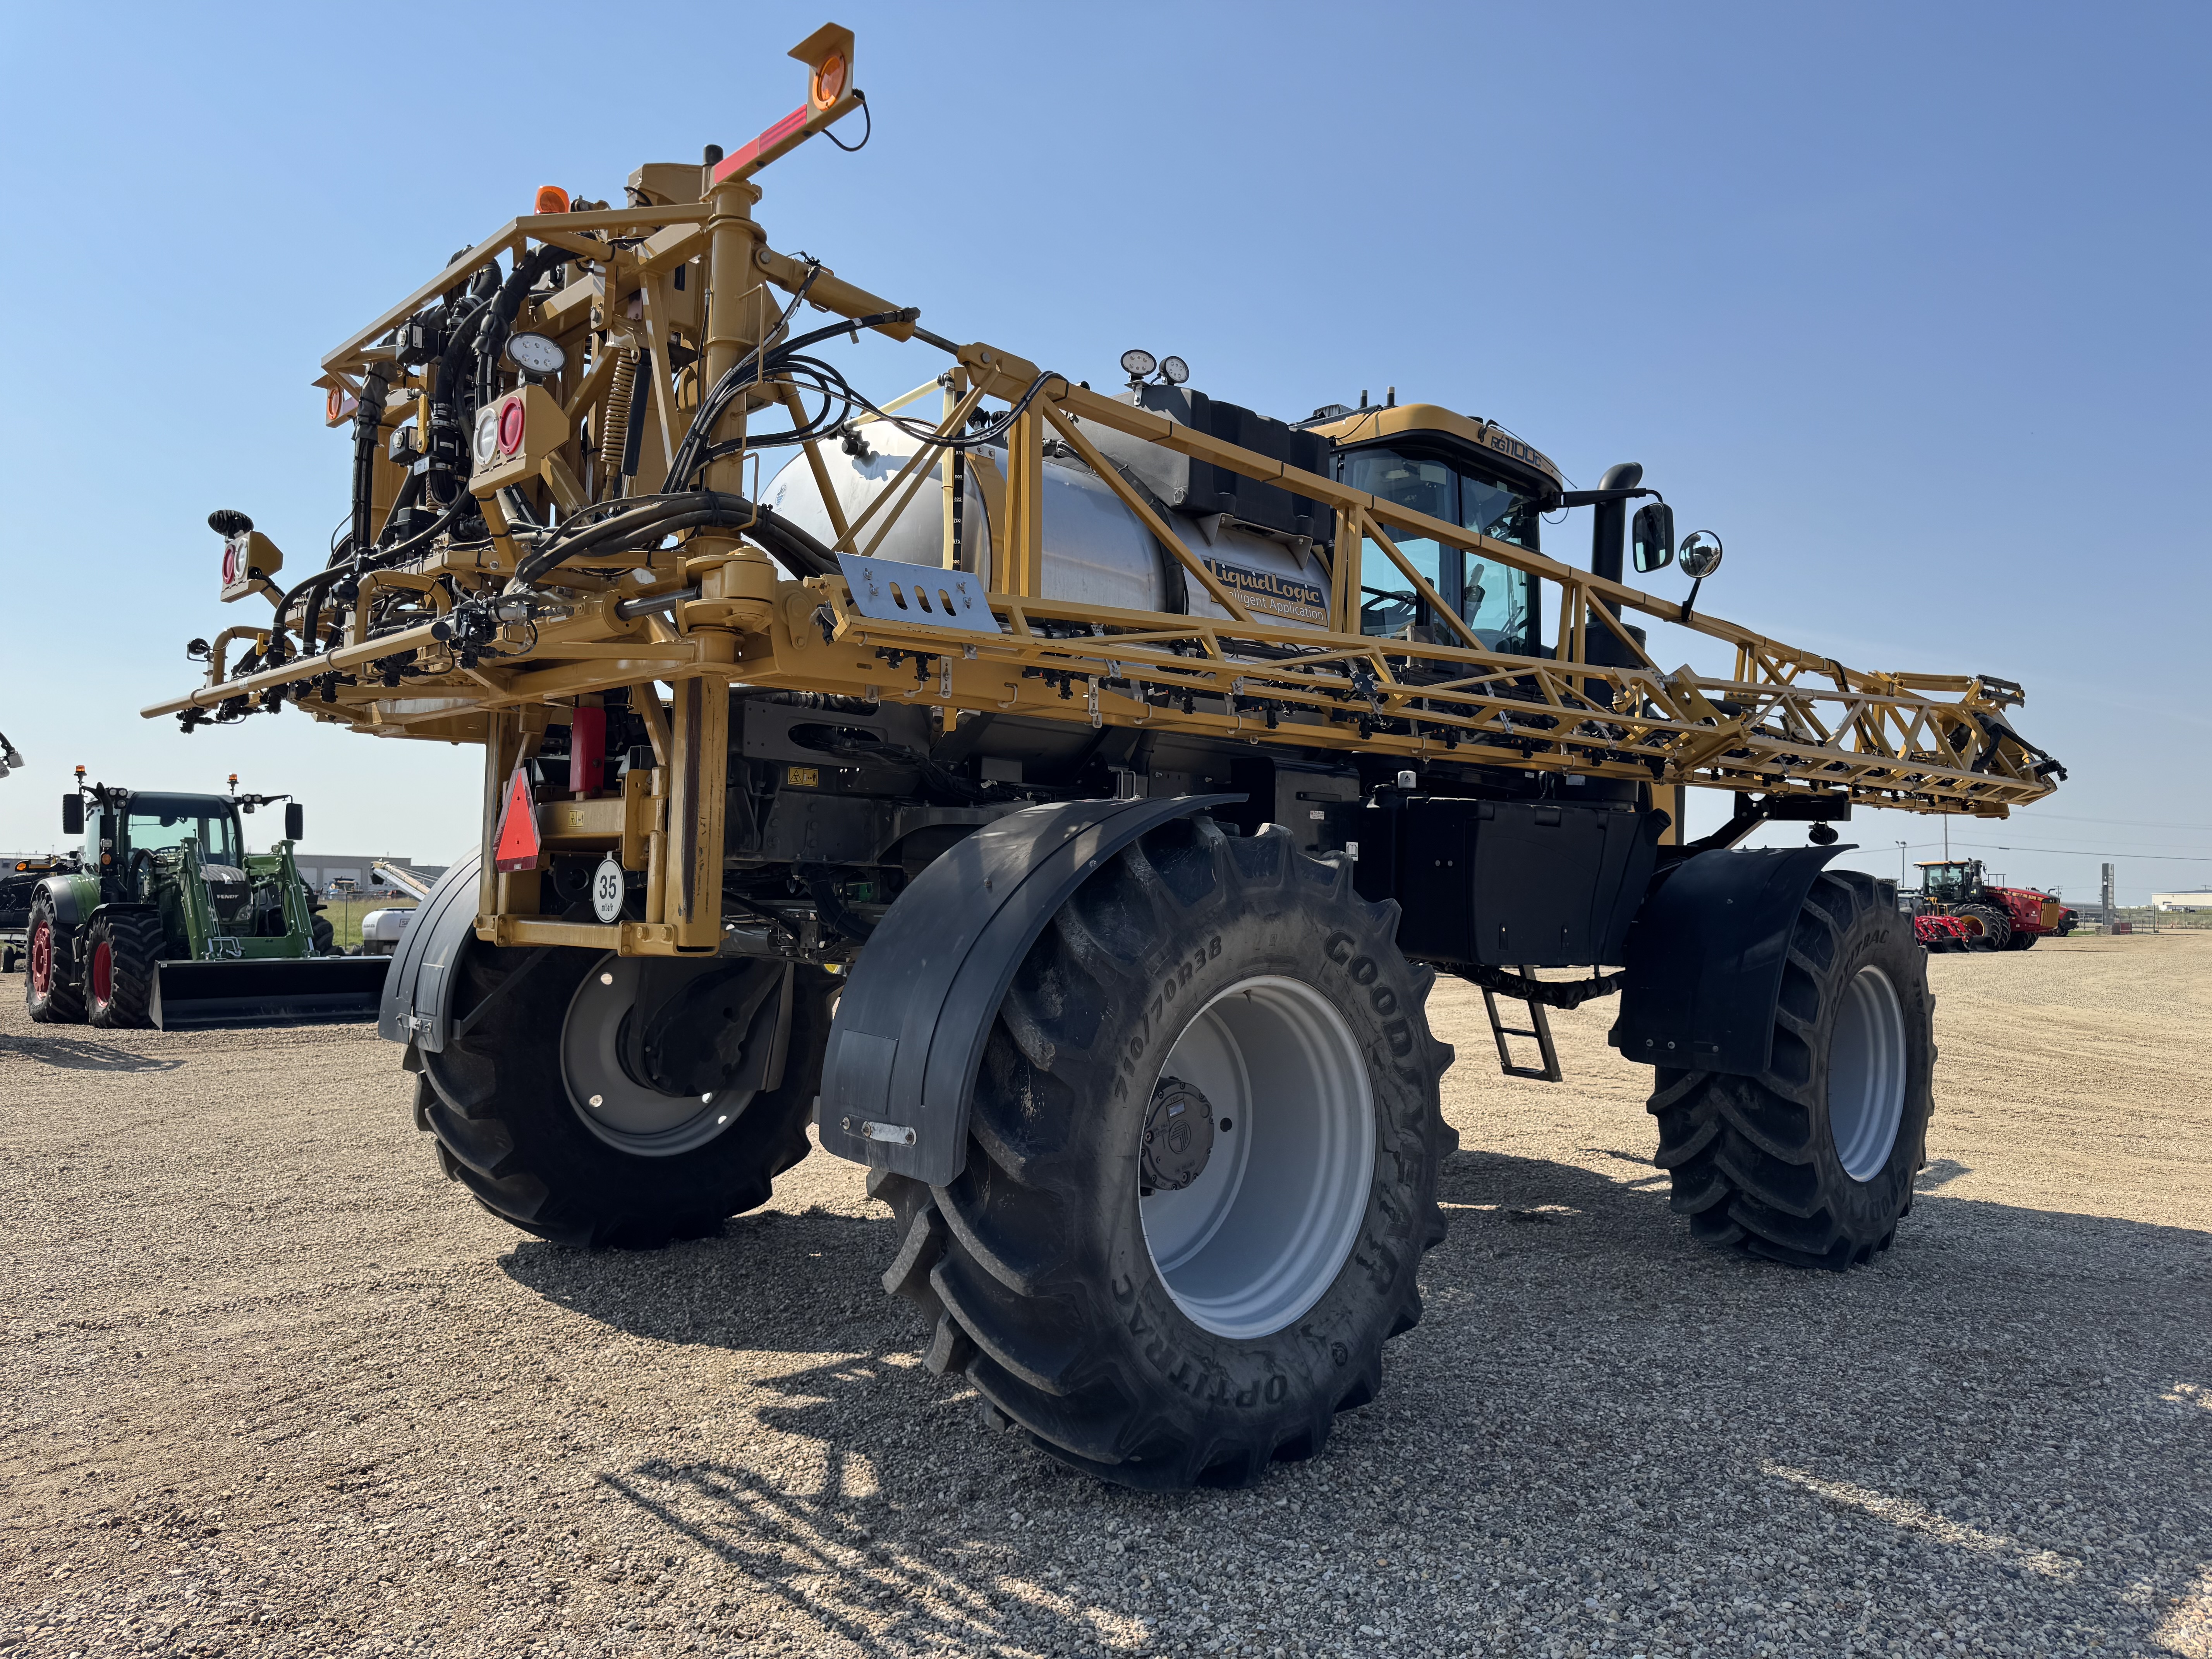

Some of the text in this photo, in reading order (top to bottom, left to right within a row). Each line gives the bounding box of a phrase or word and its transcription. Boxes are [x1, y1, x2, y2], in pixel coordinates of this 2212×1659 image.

[1270, 598, 1324, 621] Application
[599, 875, 617, 899] 35
[1115, 936, 1222, 1103] 710/70R38
